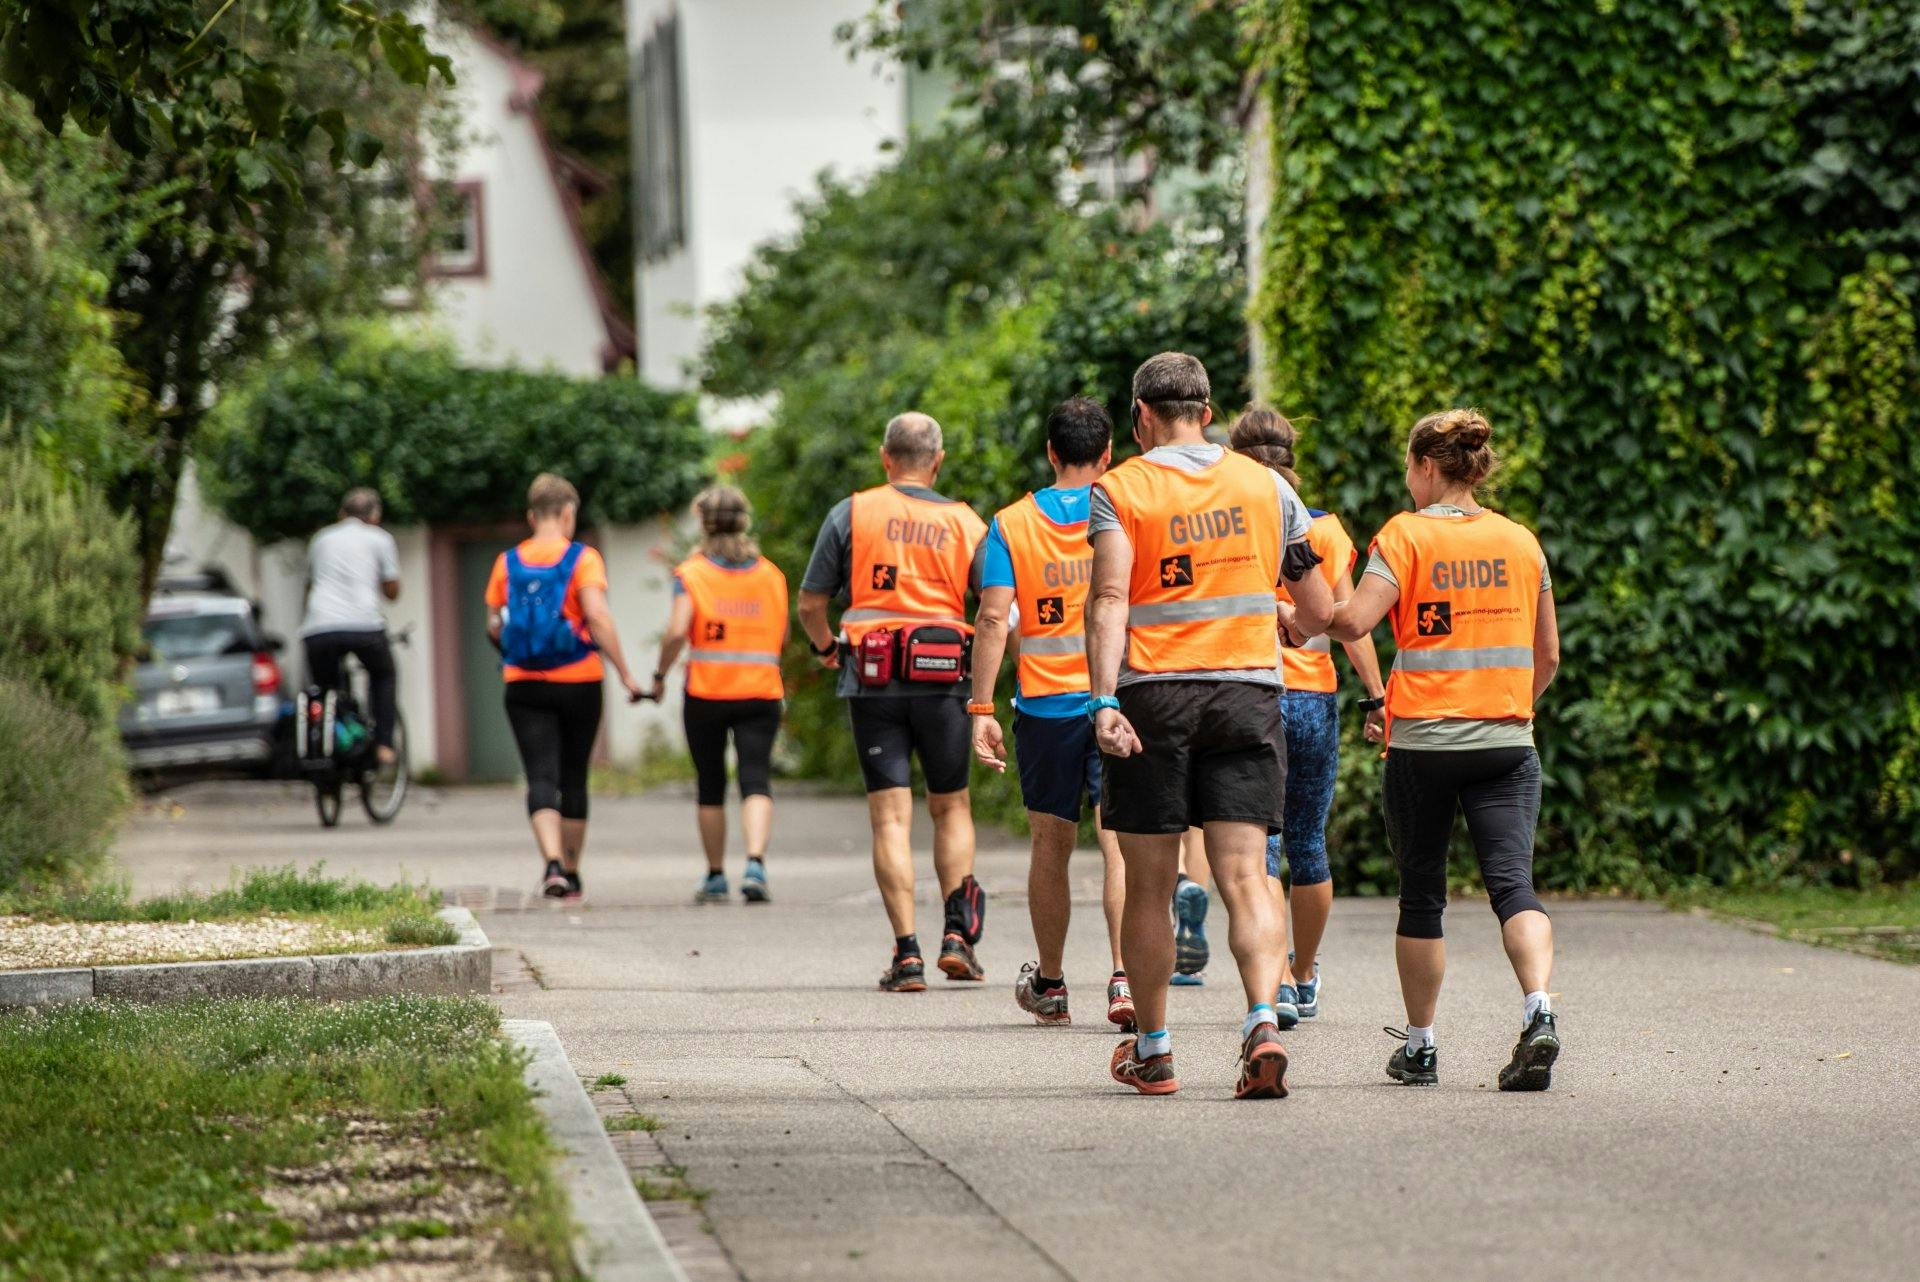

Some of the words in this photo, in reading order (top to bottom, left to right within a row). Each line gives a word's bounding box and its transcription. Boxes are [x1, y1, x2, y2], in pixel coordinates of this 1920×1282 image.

[887, 518, 949, 551] GUIDE
[1170, 506, 1246, 545] GUIDE
[1044, 559, 1093, 588] GUI
[1431, 558, 1508, 590] GUIDE
